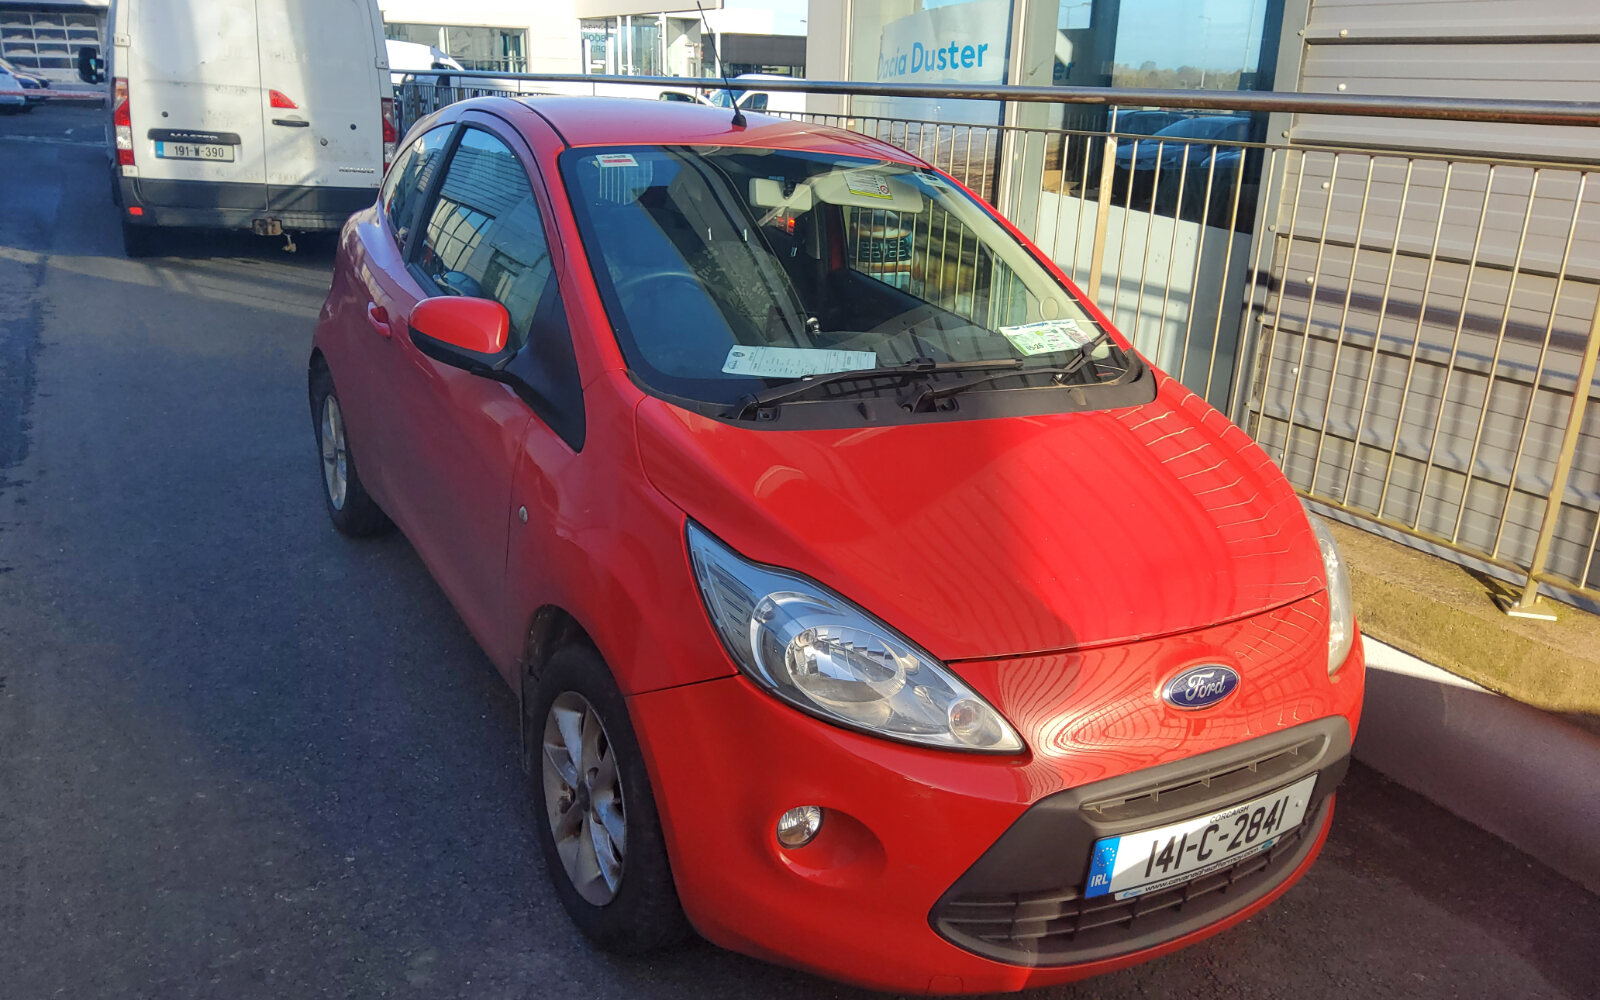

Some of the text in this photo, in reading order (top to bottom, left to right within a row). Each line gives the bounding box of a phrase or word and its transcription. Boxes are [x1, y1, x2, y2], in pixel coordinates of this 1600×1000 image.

[911, 40, 988, 74] Duster
[174, 145, 224, 158] 191-W-390
[1185, 671, 1226, 701] Ford
[1210, 805, 1249, 823] CORCAIGH
[1144, 796, 1290, 878] 141-C-2841
[1091, 873, 1109, 887] IRL
